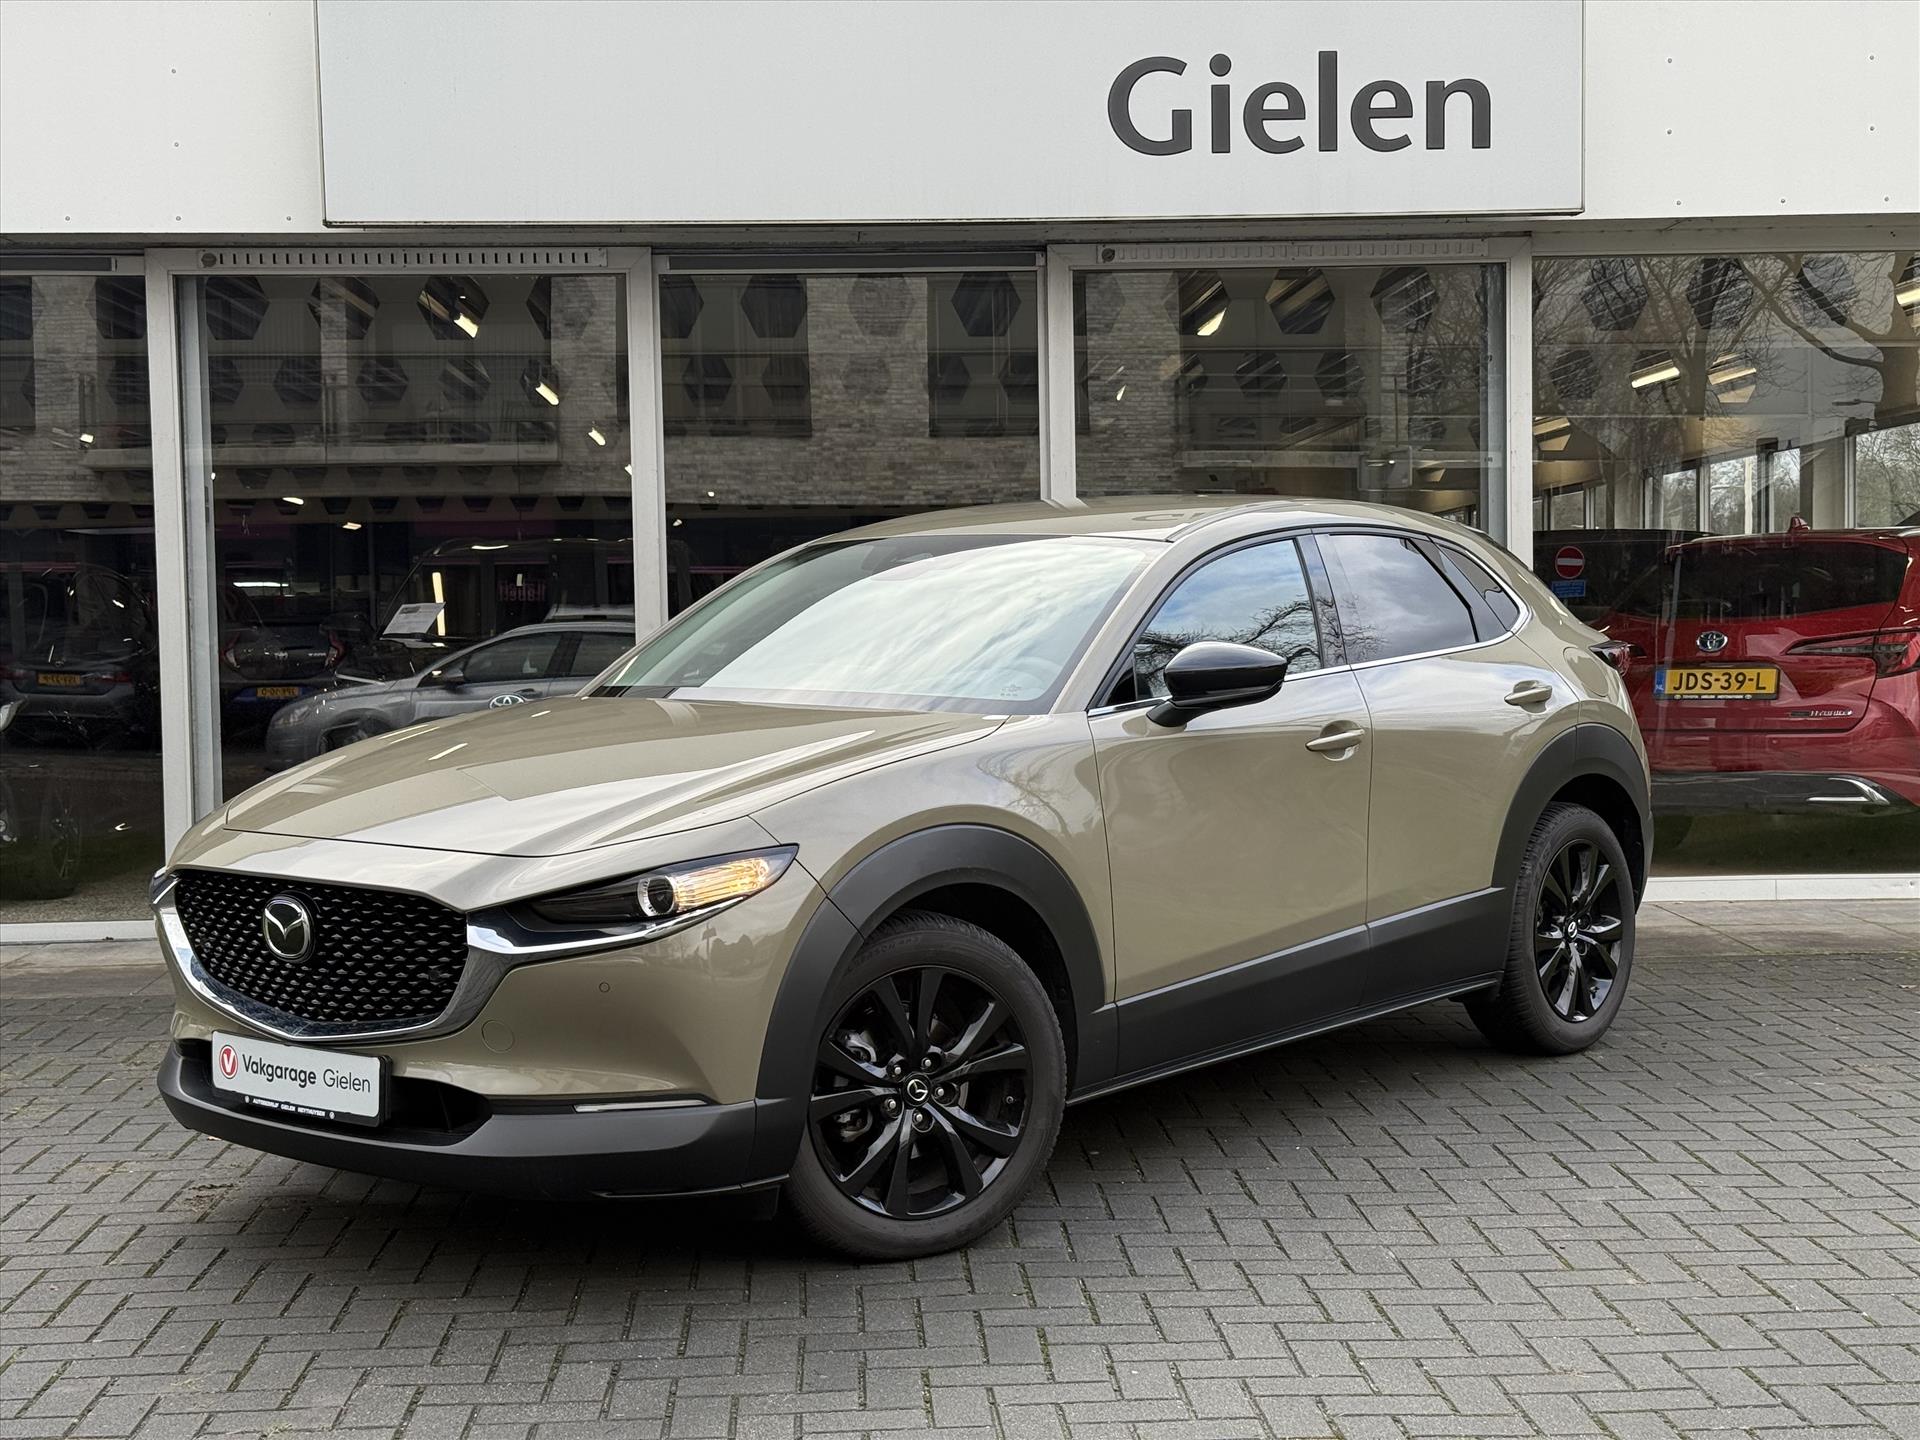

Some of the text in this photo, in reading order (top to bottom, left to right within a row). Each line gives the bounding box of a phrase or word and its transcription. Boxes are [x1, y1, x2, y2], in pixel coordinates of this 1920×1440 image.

[1107, 50, 1491, 156] Gielen
[1673, 672, 1766, 691] JDS-39-L
[242, 1053, 371, 1093] Vakgarage Gielen
